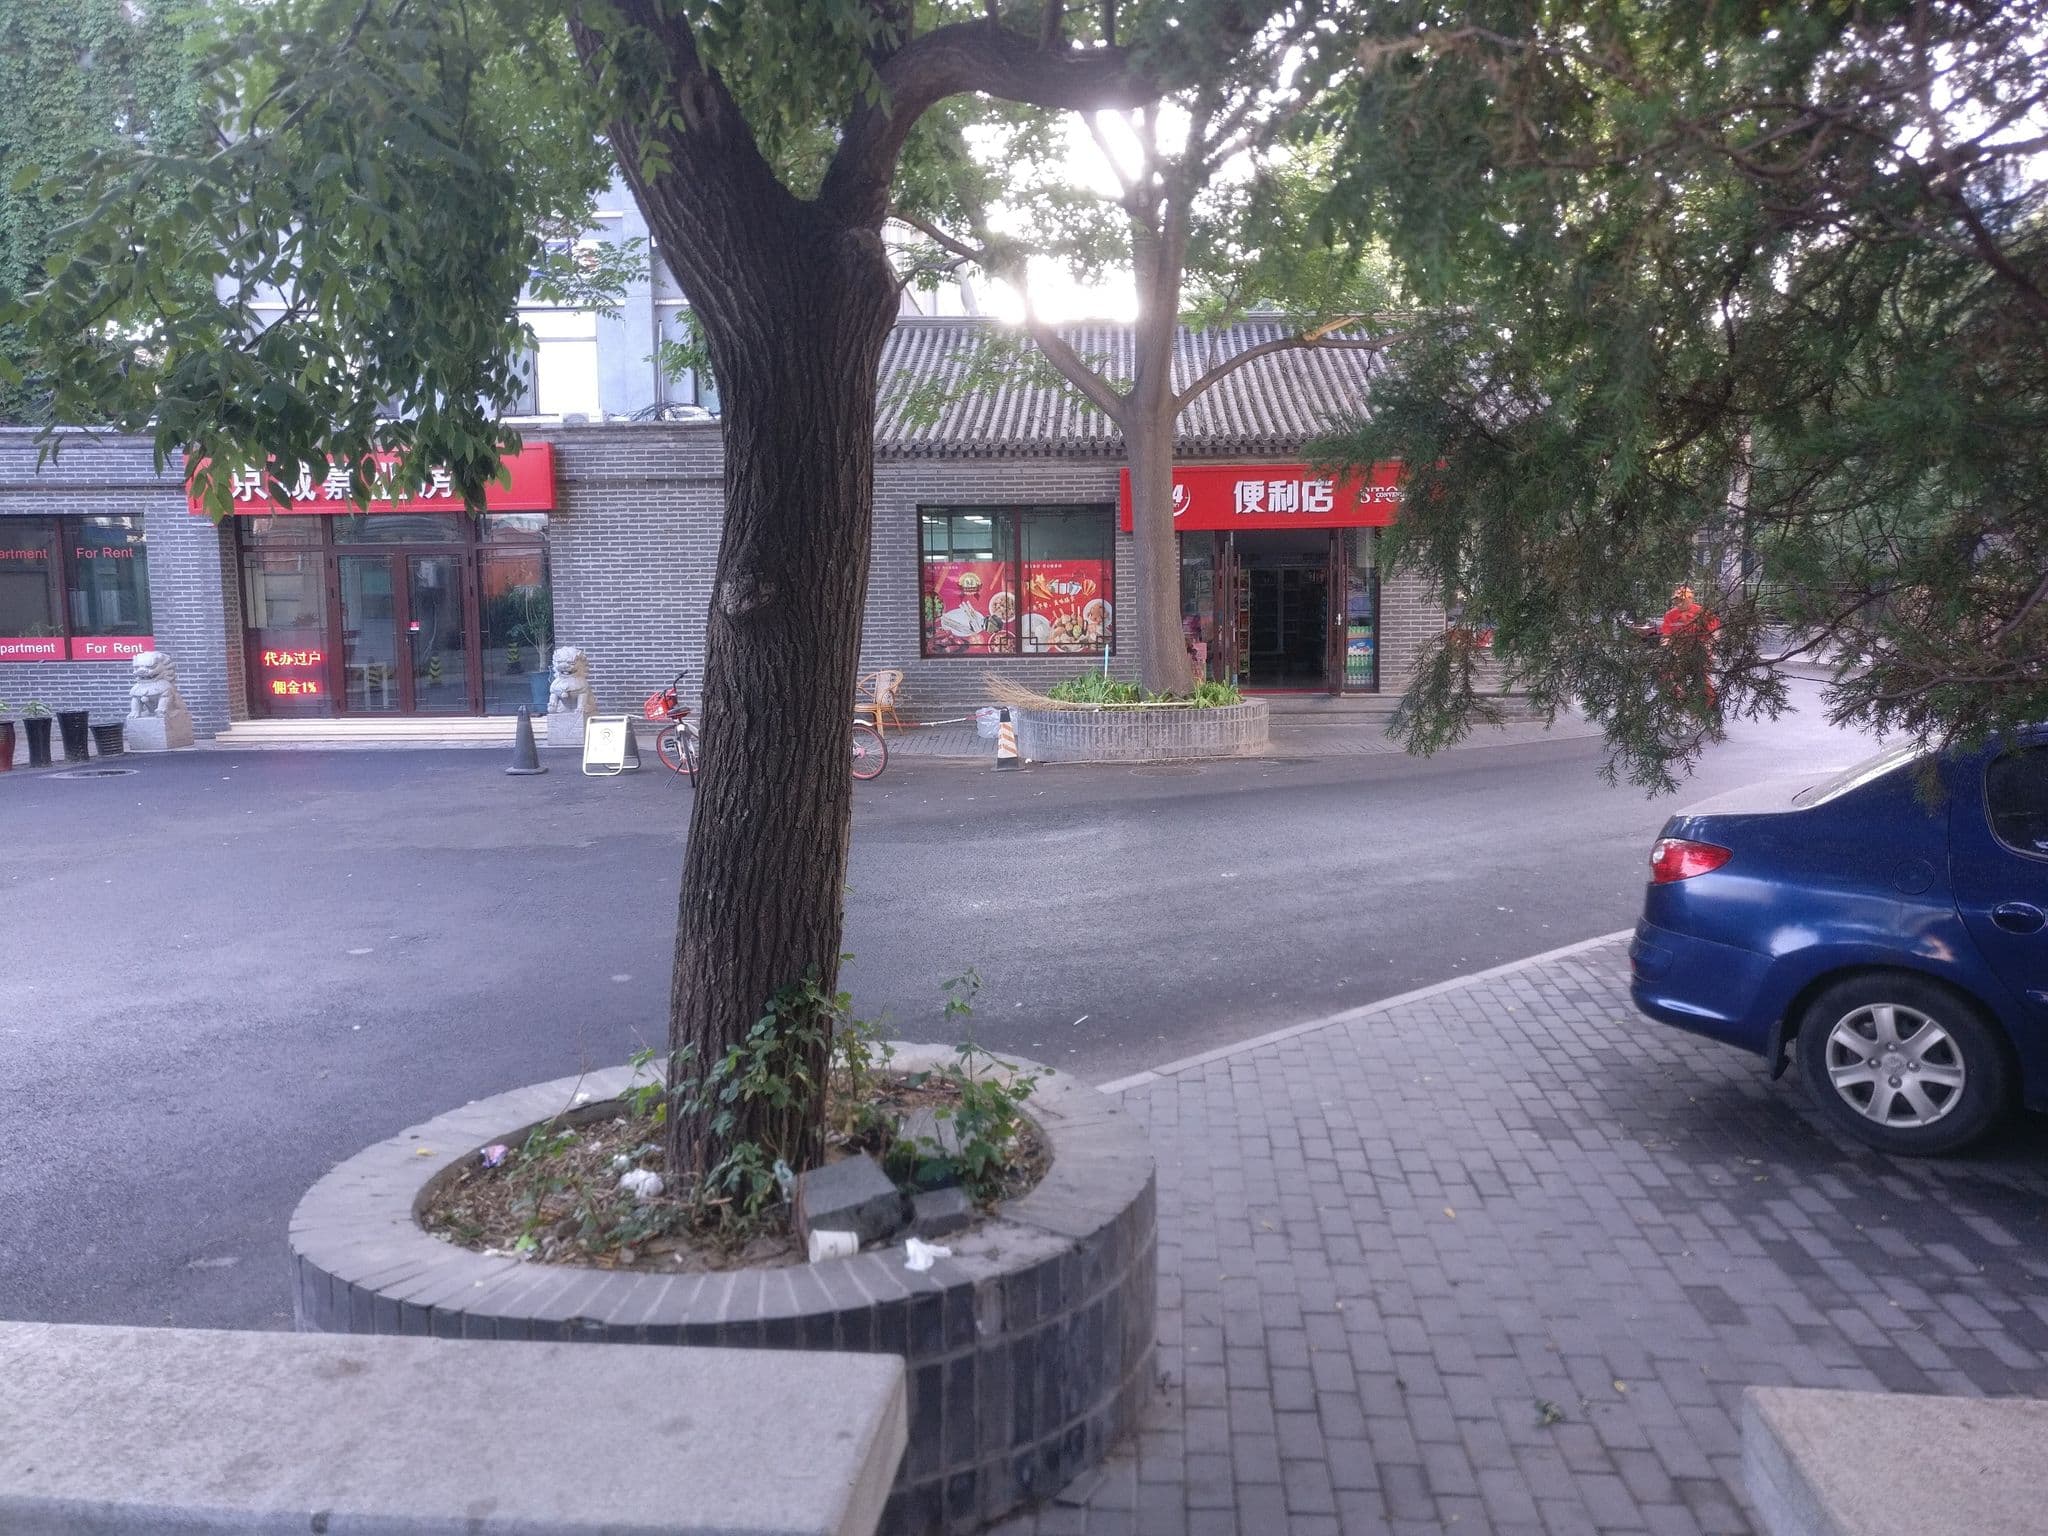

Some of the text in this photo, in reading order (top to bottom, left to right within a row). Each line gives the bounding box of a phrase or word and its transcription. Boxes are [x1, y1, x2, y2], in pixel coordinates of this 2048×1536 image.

[1233, 479, 1334, 514] 便利店
[1360, 486, 1405, 504] STO
[76, 547, 98, 559] For
[103, 547, 133, 559] Rent
[0, 642, 144, 656] partment For Rent
[264, 651, 321, 666] 代办过户
[272, 680, 317, 695] 佣金1%
